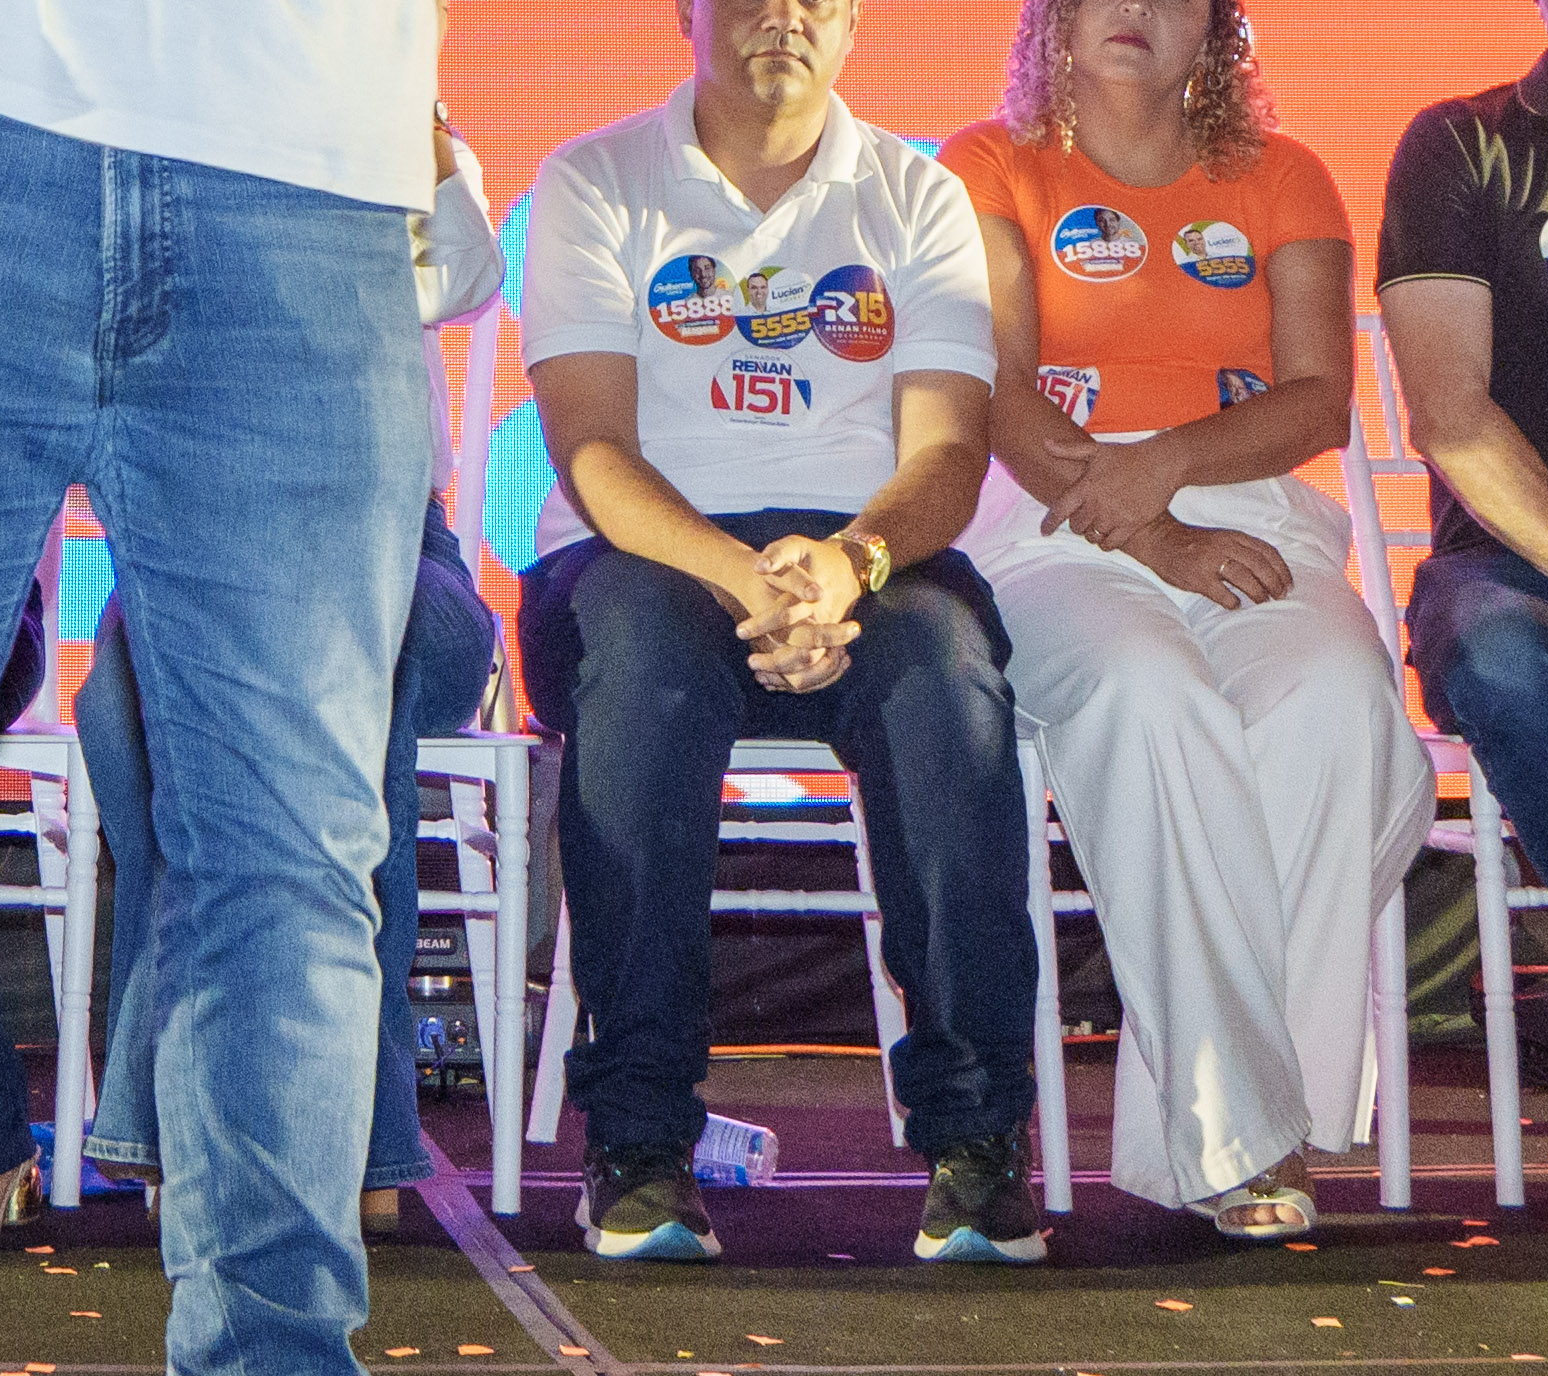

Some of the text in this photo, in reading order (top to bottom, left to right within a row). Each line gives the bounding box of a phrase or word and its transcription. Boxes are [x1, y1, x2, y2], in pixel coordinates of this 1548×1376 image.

[1062, 239, 1143, 263] 15888
[1196, 257, 1251, 277] 5555
[655, 293, 734, 323] 15888
[854, 291, 888, 325] 15
[750, 310, 812, 339] 5555
[732, 359, 793, 376] RENAN
[732, 373, 792, 415] 151
